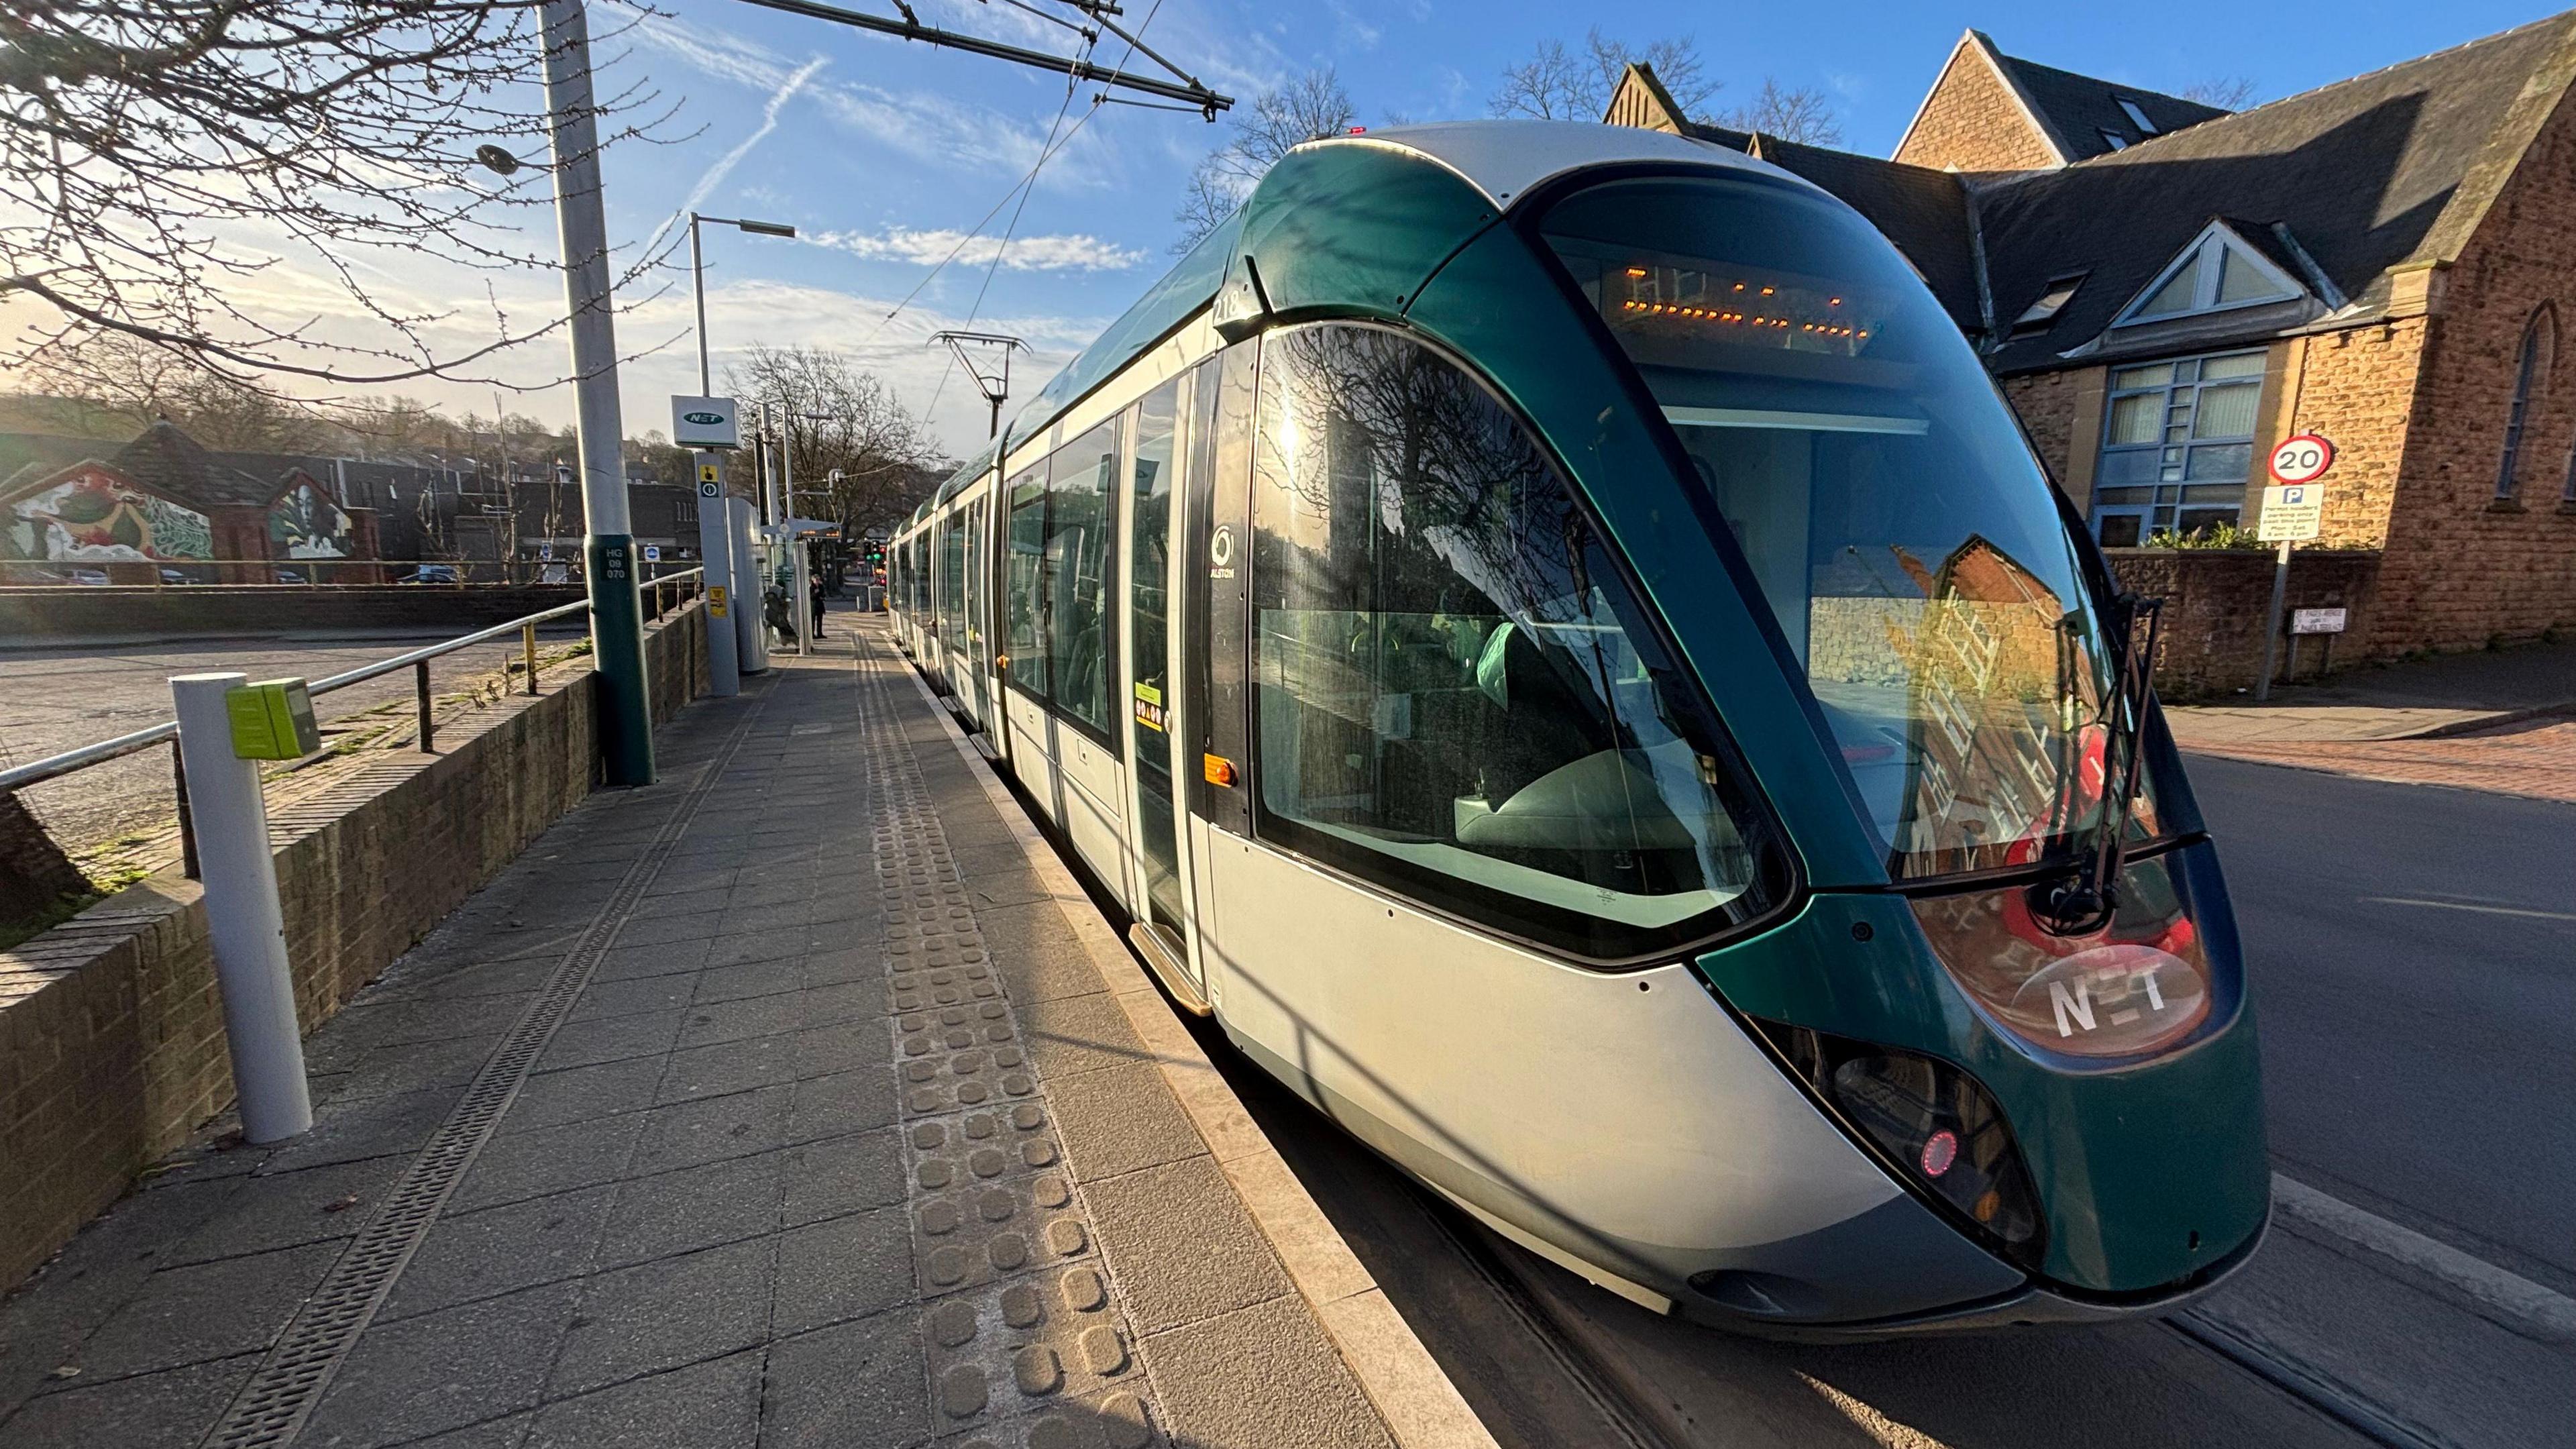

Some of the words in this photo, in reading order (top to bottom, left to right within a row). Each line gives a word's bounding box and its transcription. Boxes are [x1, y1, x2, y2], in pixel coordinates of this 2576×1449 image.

[1213, 290, 1239, 325] 218
[690, 414, 718, 423] NET
[2278, 449, 2320, 470] 20
[2286, 489, 2302, 503] P
[606, 549, 623, 557] HG
[608, 559, 622, 568] 09
[606, 570, 625, 578] 070
[2048, 963, 2165, 1038] NET
